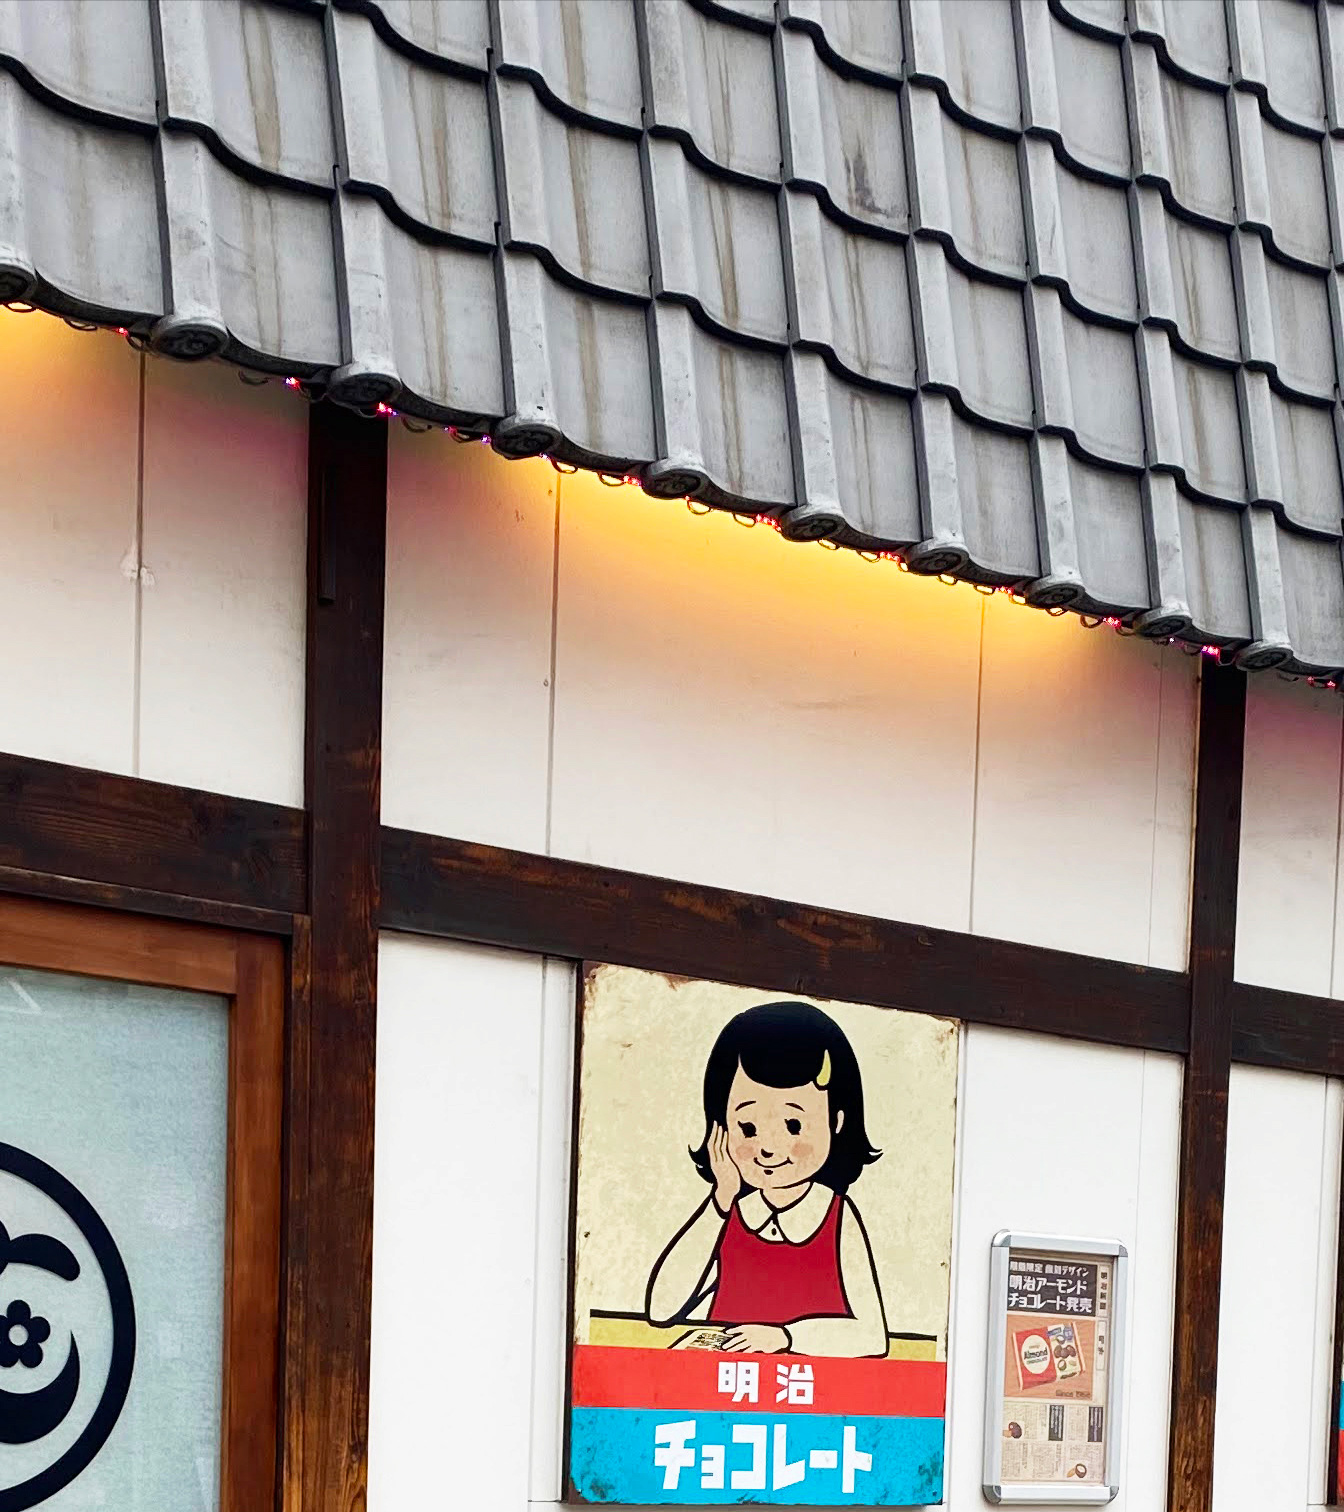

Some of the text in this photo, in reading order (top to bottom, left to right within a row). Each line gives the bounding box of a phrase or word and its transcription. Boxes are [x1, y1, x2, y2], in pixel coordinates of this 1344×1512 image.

[1009, 1275, 1088, 1295] 明治アーモンド
[1008, 1292, 1093, 1313] チョコレート発売
[717, 1360, 815, 1406] 明治
[654, 1419, 872, 1493] チョコレート
